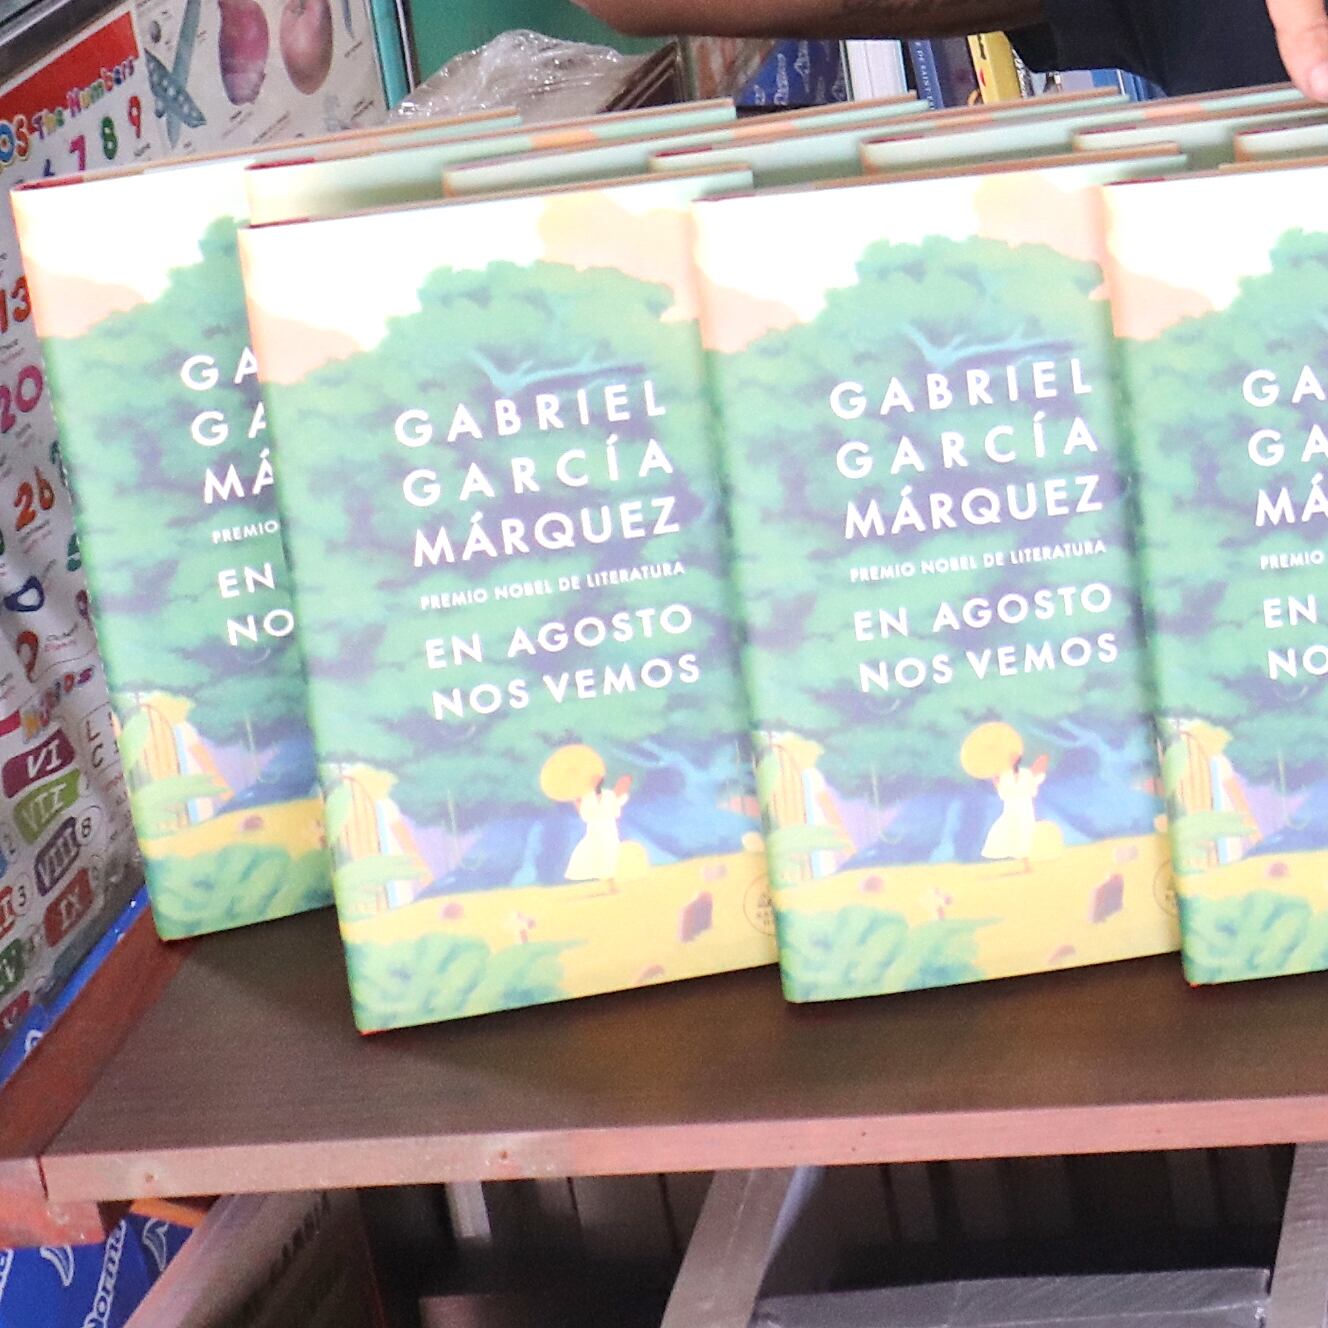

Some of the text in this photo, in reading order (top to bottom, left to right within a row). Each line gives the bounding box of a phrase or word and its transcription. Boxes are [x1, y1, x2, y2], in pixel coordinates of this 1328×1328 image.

[394, 380, 667, 448] GABRIEL
[830, 358, 1093, 419] GABRIEL
[402, 434, 674, 507] GARCÍA
[836, 411, 1098, 479] GARCÍA
[413, 496, 680, 568] MÁRQUEZ
[845, 474, 1103, 539] MÁRQUEZ
[420, 561, 685, 611] PREMIO NOBEL DE LITERATURA
[854, 583, 1111, 641] EN AGOSTO
[1263, 594, 1317, 628] EN
[425, 604, 692, 670] EN AGOSTO
[859, 633, 1118, 693] NOS VEMOS
[431, 654, 699, 720] NOS VEMOS
